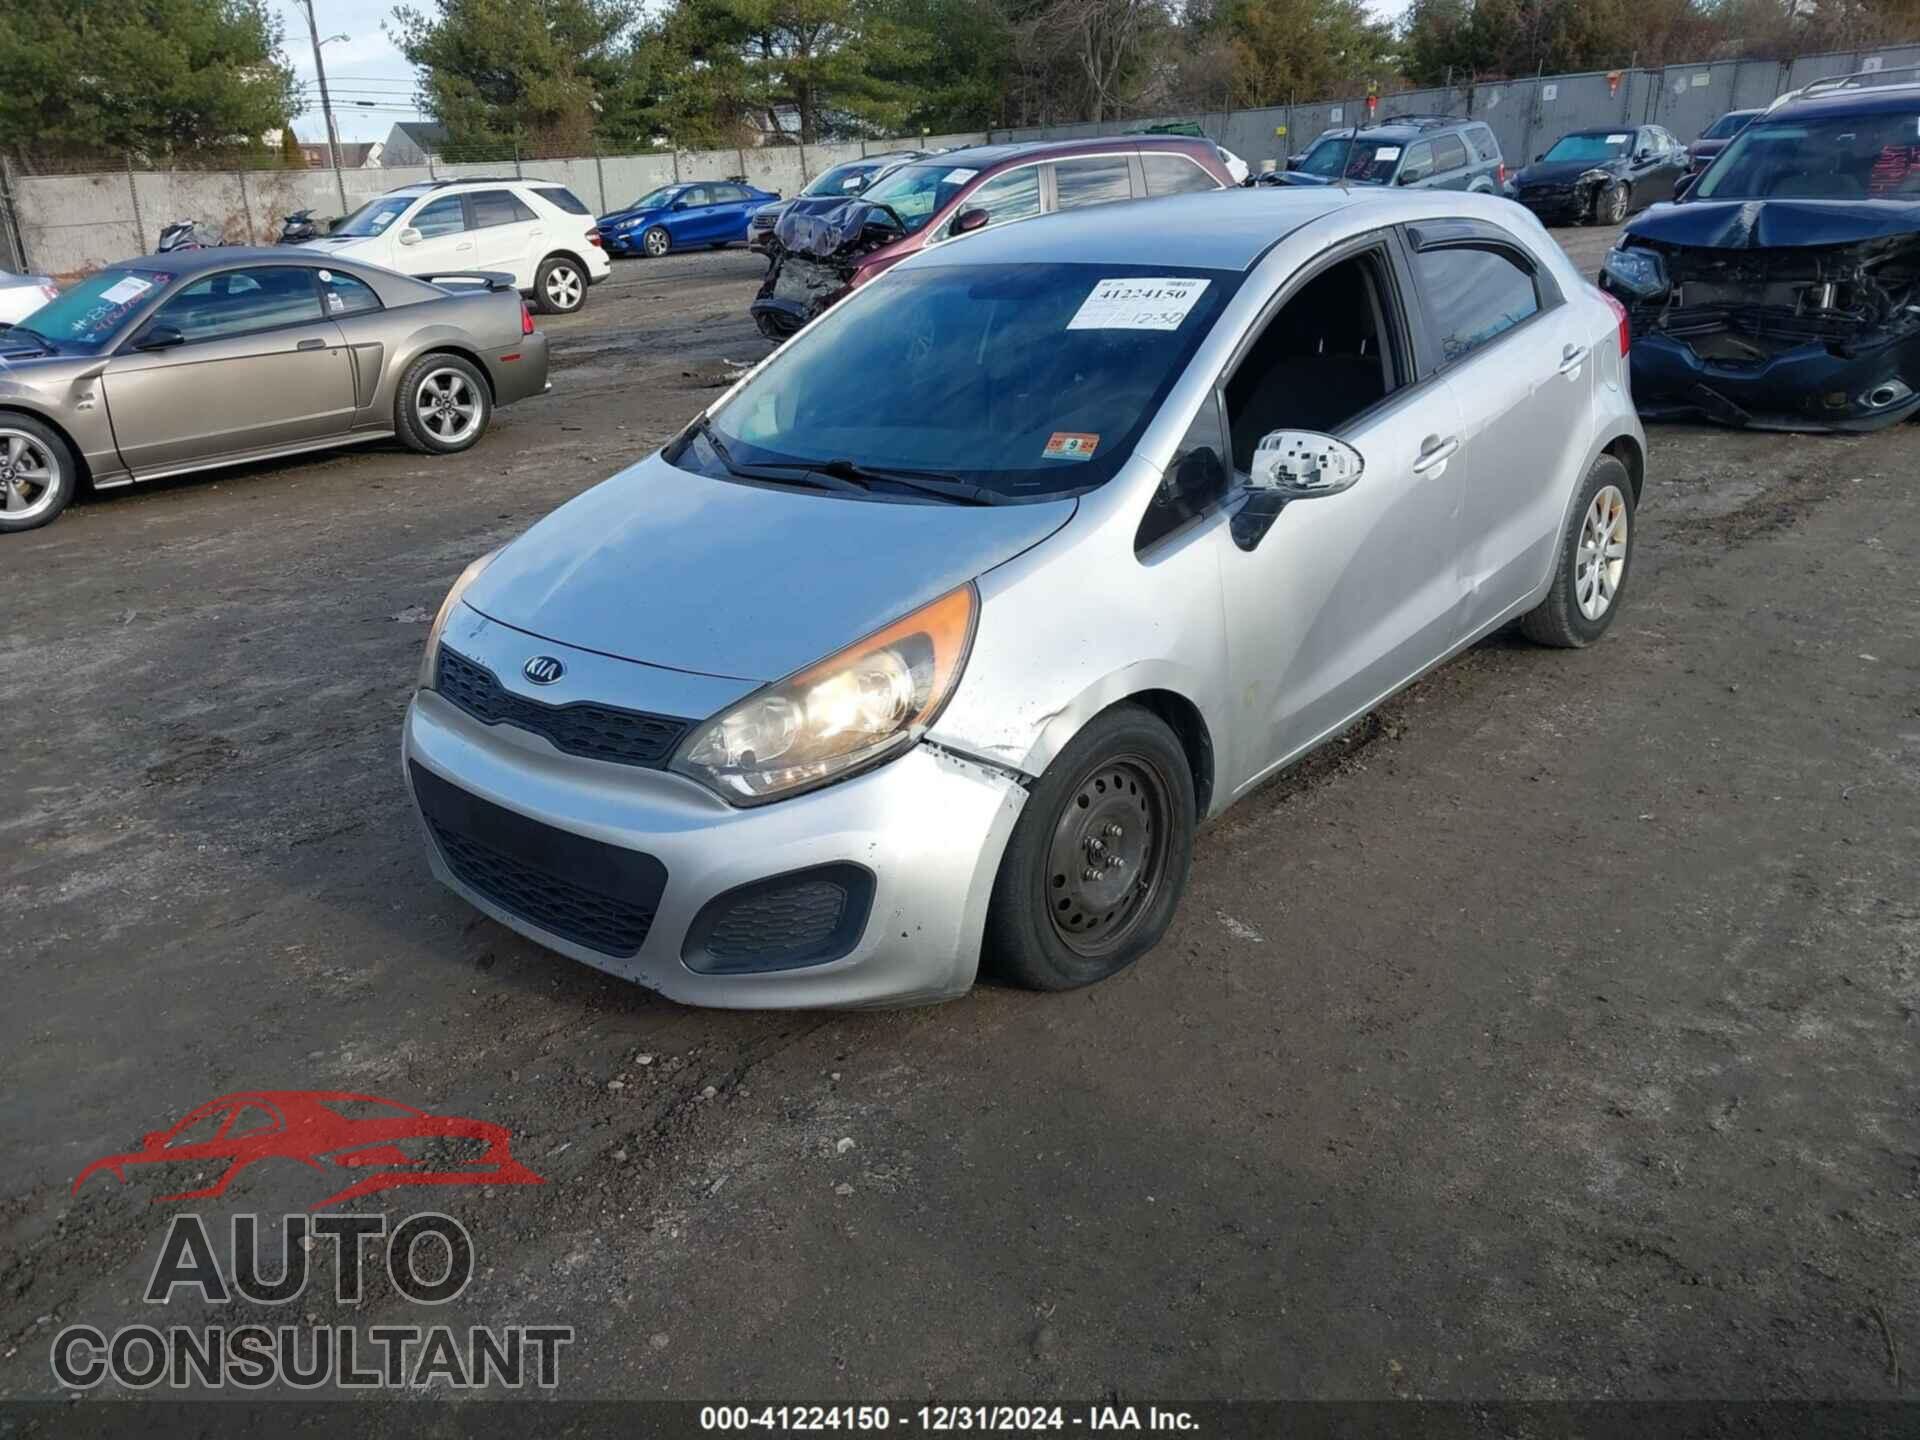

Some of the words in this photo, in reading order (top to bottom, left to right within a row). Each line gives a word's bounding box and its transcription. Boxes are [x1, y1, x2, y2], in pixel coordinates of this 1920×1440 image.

[1100, 288, 1187, 299] 41224150
[1068, 439, 1079, 450] 9
[526, 657, 558, 681] KIA
